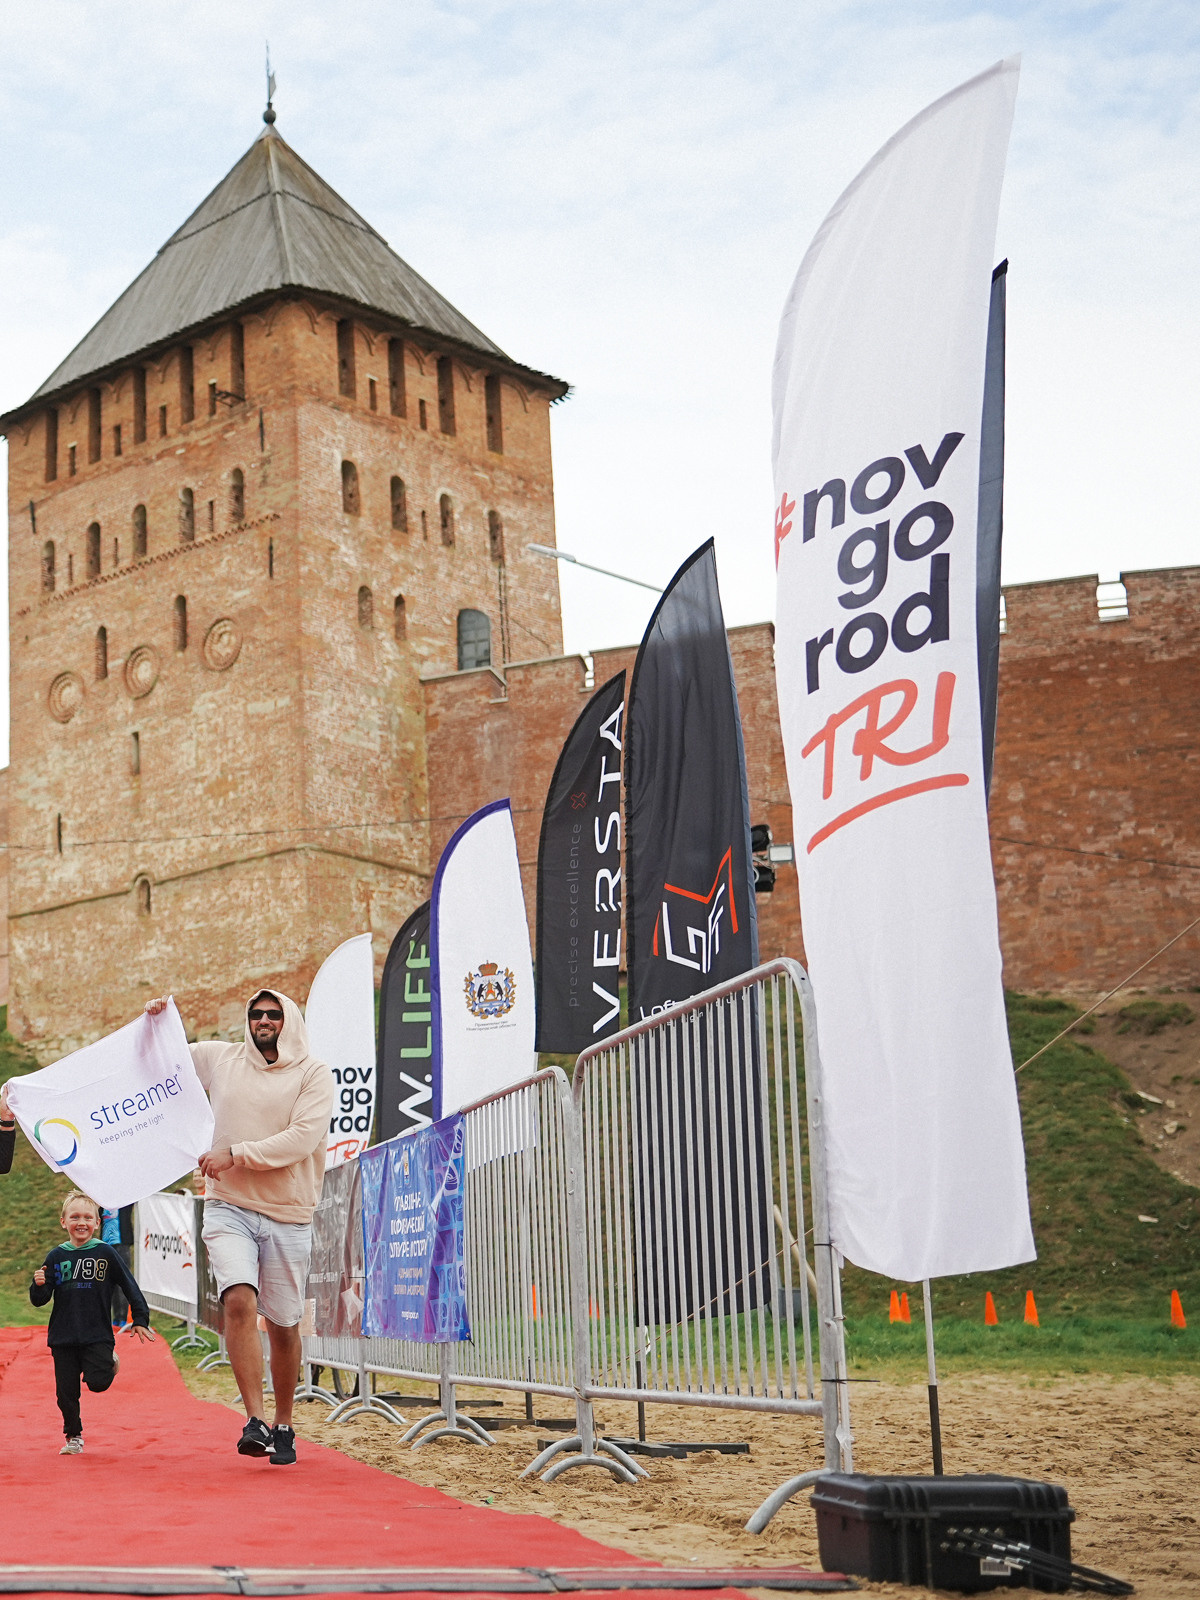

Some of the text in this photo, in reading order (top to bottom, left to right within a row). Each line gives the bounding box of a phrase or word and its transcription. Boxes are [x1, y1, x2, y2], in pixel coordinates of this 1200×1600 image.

[837, 500, 954, 610] go
[804, 553, 950, 695] rod
[801, 671, 956, 800] TRI
[566, 824, 582, 1007] precise excellence
[592, 700, 625, 1034] VERSTA
[90, 1073, 183, 1130] streamer
[99, 1113, 165, 1145] keeping the light
[330, 1106, 371, 1134] rod
[340, 1087, 373, 1113] go
